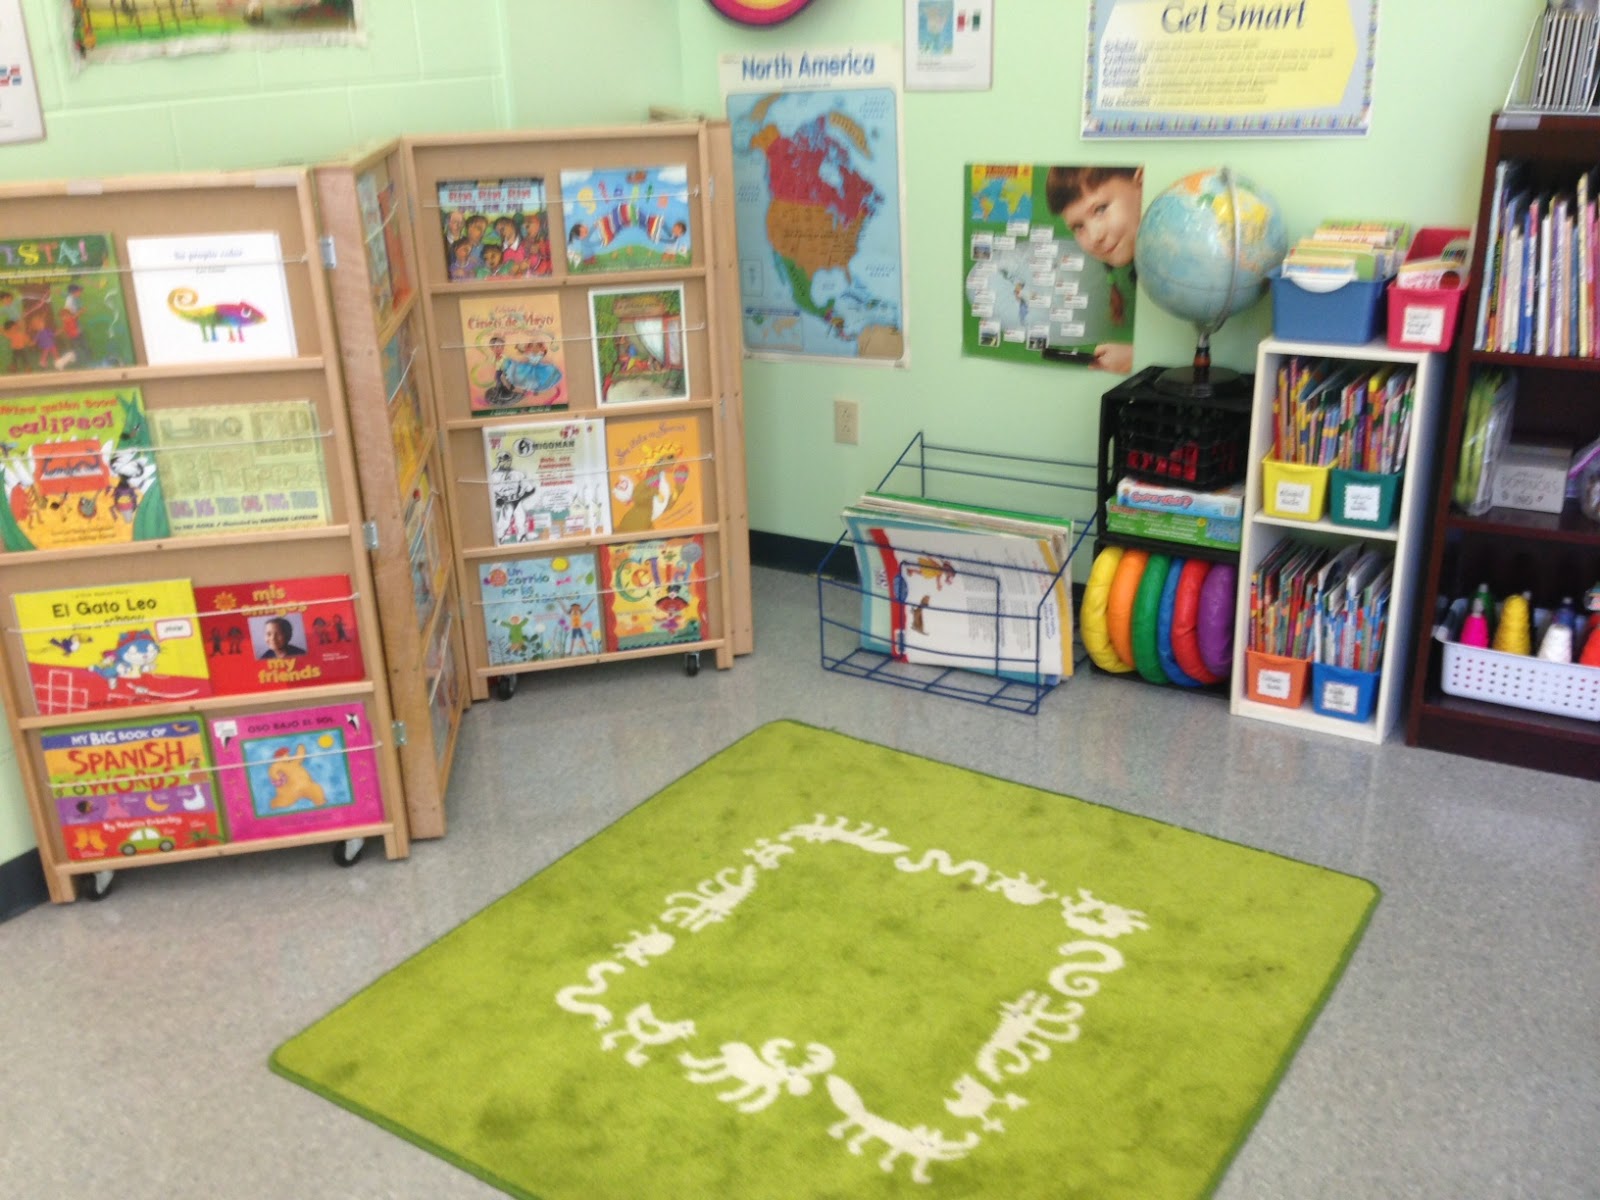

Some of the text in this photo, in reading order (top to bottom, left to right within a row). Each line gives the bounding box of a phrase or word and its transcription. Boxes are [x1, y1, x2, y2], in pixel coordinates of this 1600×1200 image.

[1216, 0, 1306, 32] Smart
[741, 47, 876, 81] North America
[252, 584, 286, 602] mis
[52, 597, 157, 619] El Gato Leo
[258, 664, 321, 683] friends
[267, 657, 296, 671] my
[71, 727, 167, 746] MY BIG BOOK OF
[67, 741, 186, 776] SPANISH
